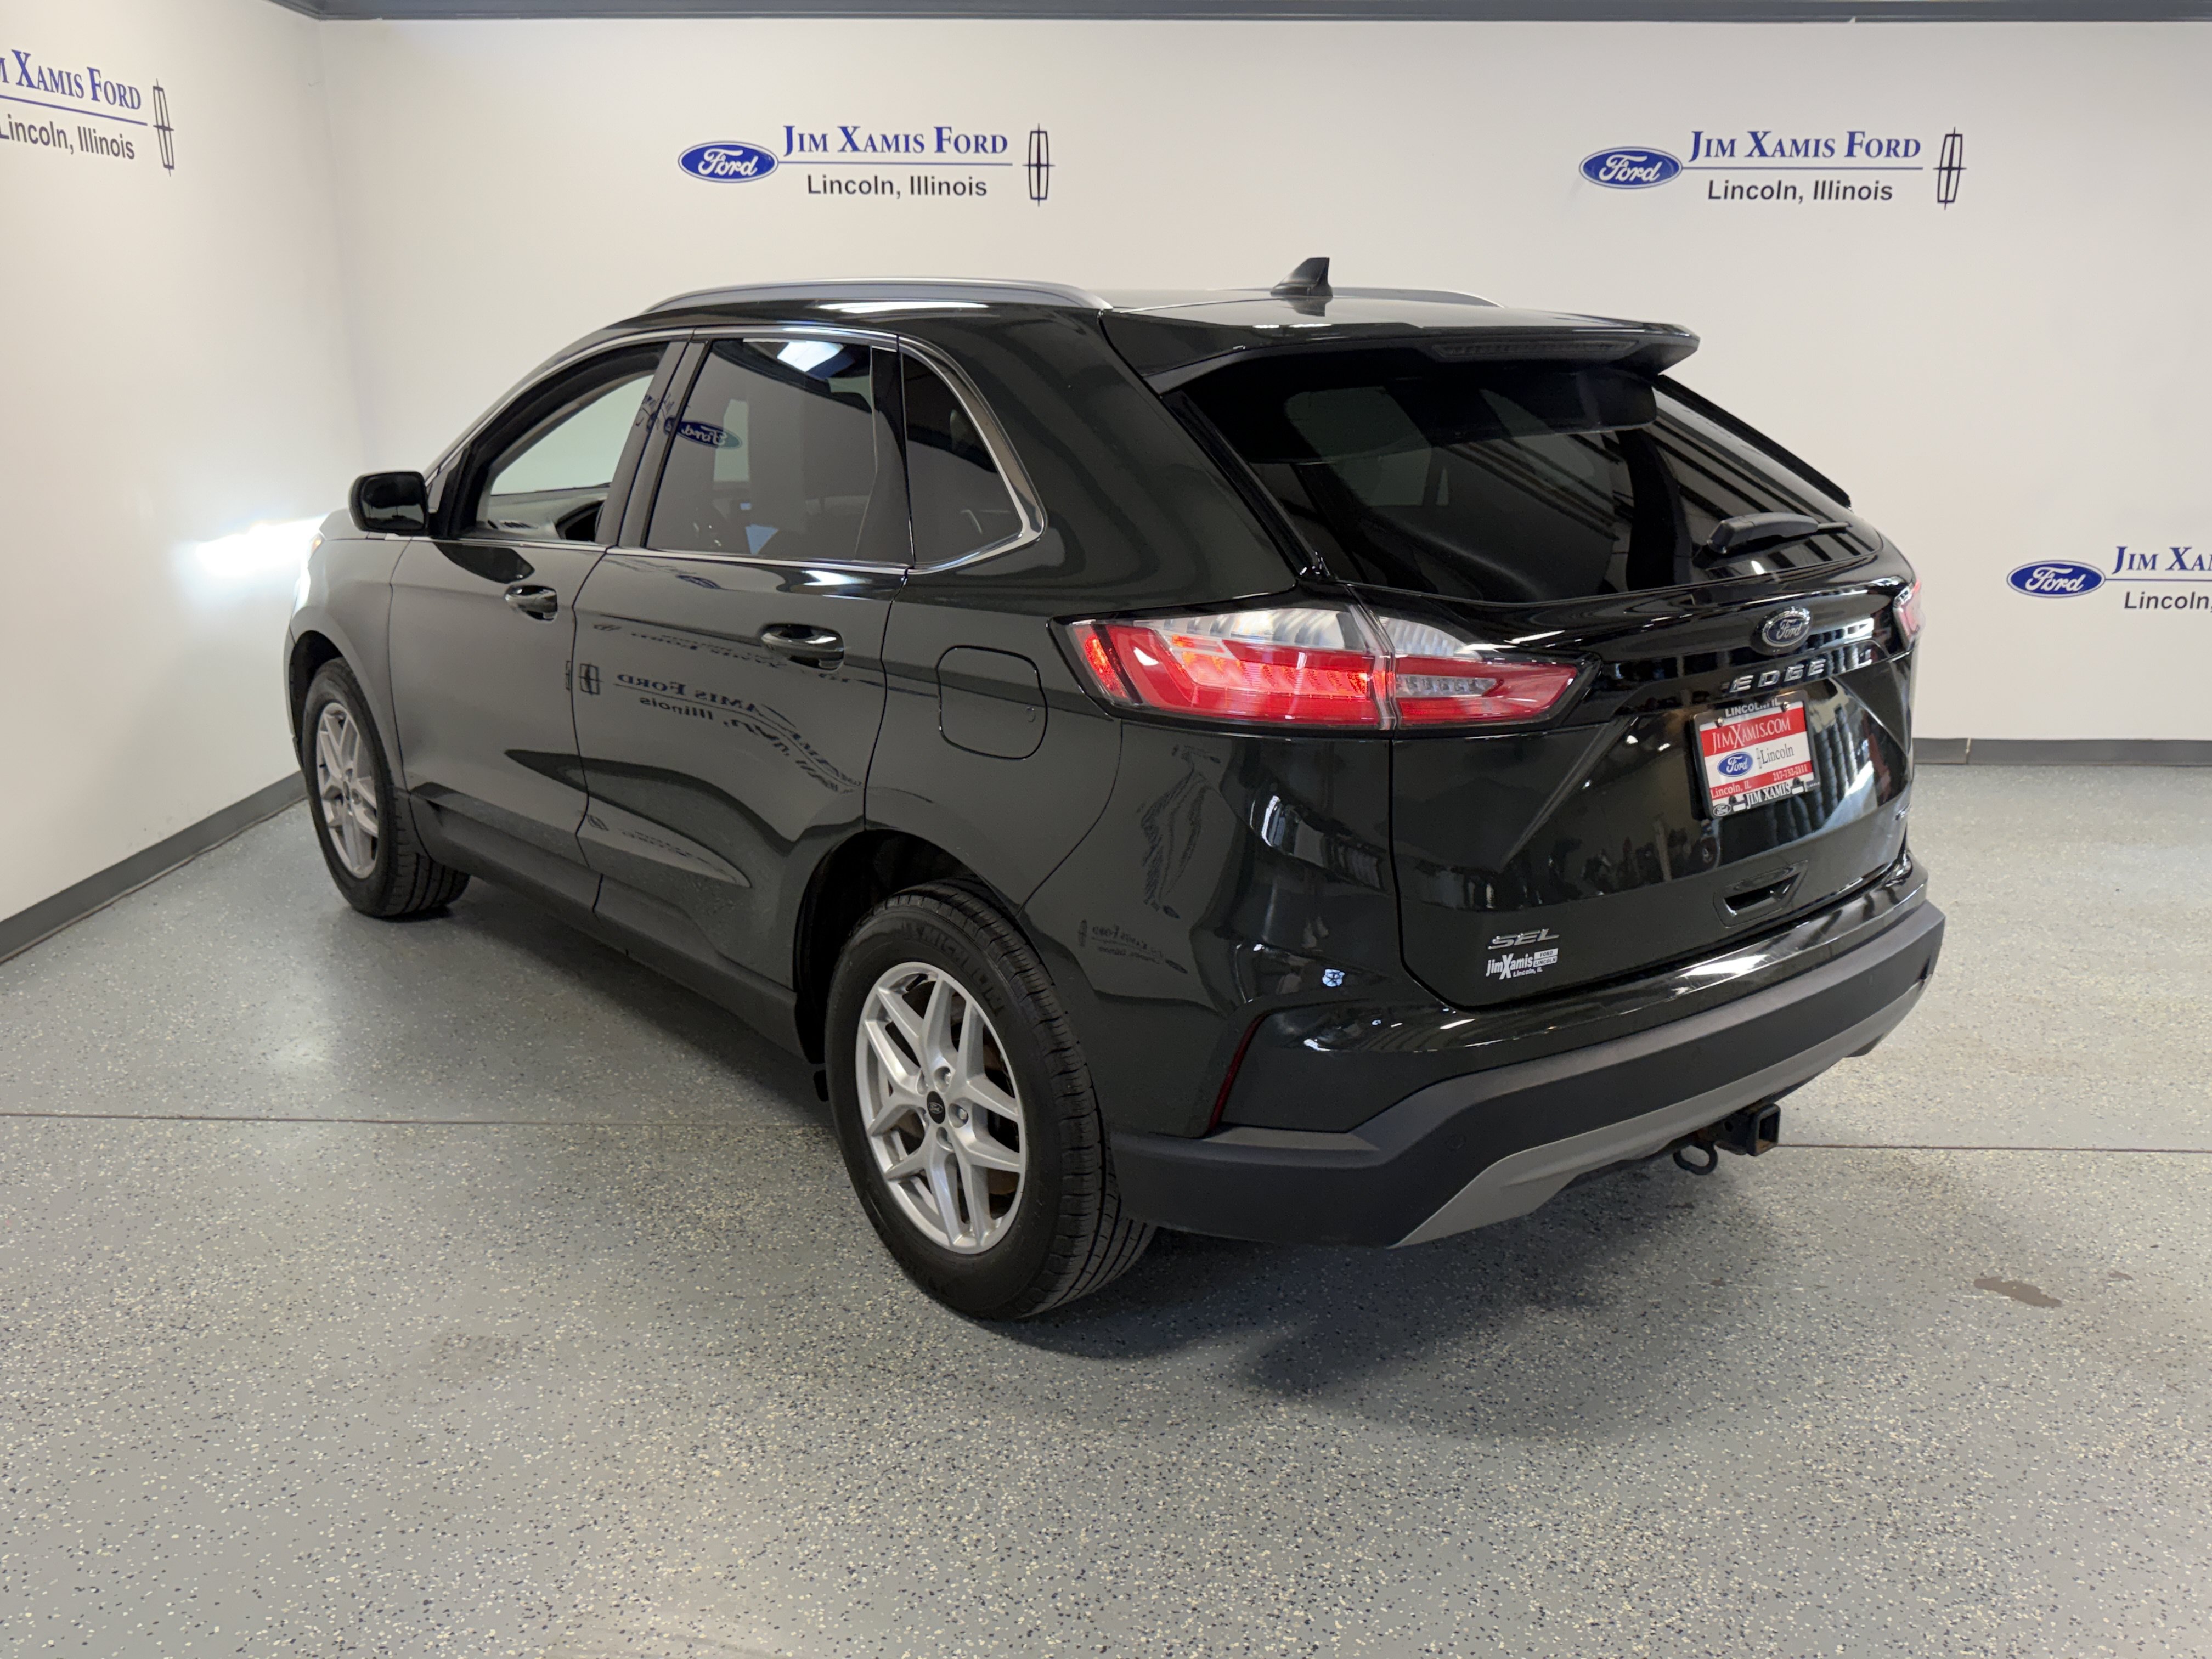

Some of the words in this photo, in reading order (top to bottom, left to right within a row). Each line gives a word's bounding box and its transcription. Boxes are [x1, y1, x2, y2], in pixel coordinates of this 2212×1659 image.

[11, 49, 84, 99] XAMIS
[87, 66, 141, 110] FORD
[77, 126, 135, 160] Illinois
[783, 125, 829, 157] JIM
[837, 126, 926, 154] XAMIS
[934, 126, 1008, 154] FORD
[1688, 131, 1737, 162] JIM
[1744, 131, 1836, 159] XAMIS
[1843, 131, 1921, 159] FORD
[697, 148, 759, 176] Ford
[1598, 154, 1663, 182] Ford
[807, 174, 901, 199] Lincoln,
[910, 175, 988, 196] Illinois
[1708, 179, 1804, 205] Lincoln,
[1813, 180, 1894, 201] Illinois
[2112, 546, 2159, 575] JIM
[2024, 566, 2087, 593] Ford
[1776, 618, 1803, 640] Ford
[1729, 659, 1826, 693] EDGE
[1712, 717, 1791, 754] JIMXAMIS.COM
[1726, 755, 1748, 774] Ford
[1760, 743, 1795, 765] Lincoln
[1745, 793, 1763, 809] JIM
[1763, 783, 1792, 802] XAMIS
[1487, 928, 1560, 950] SEL
